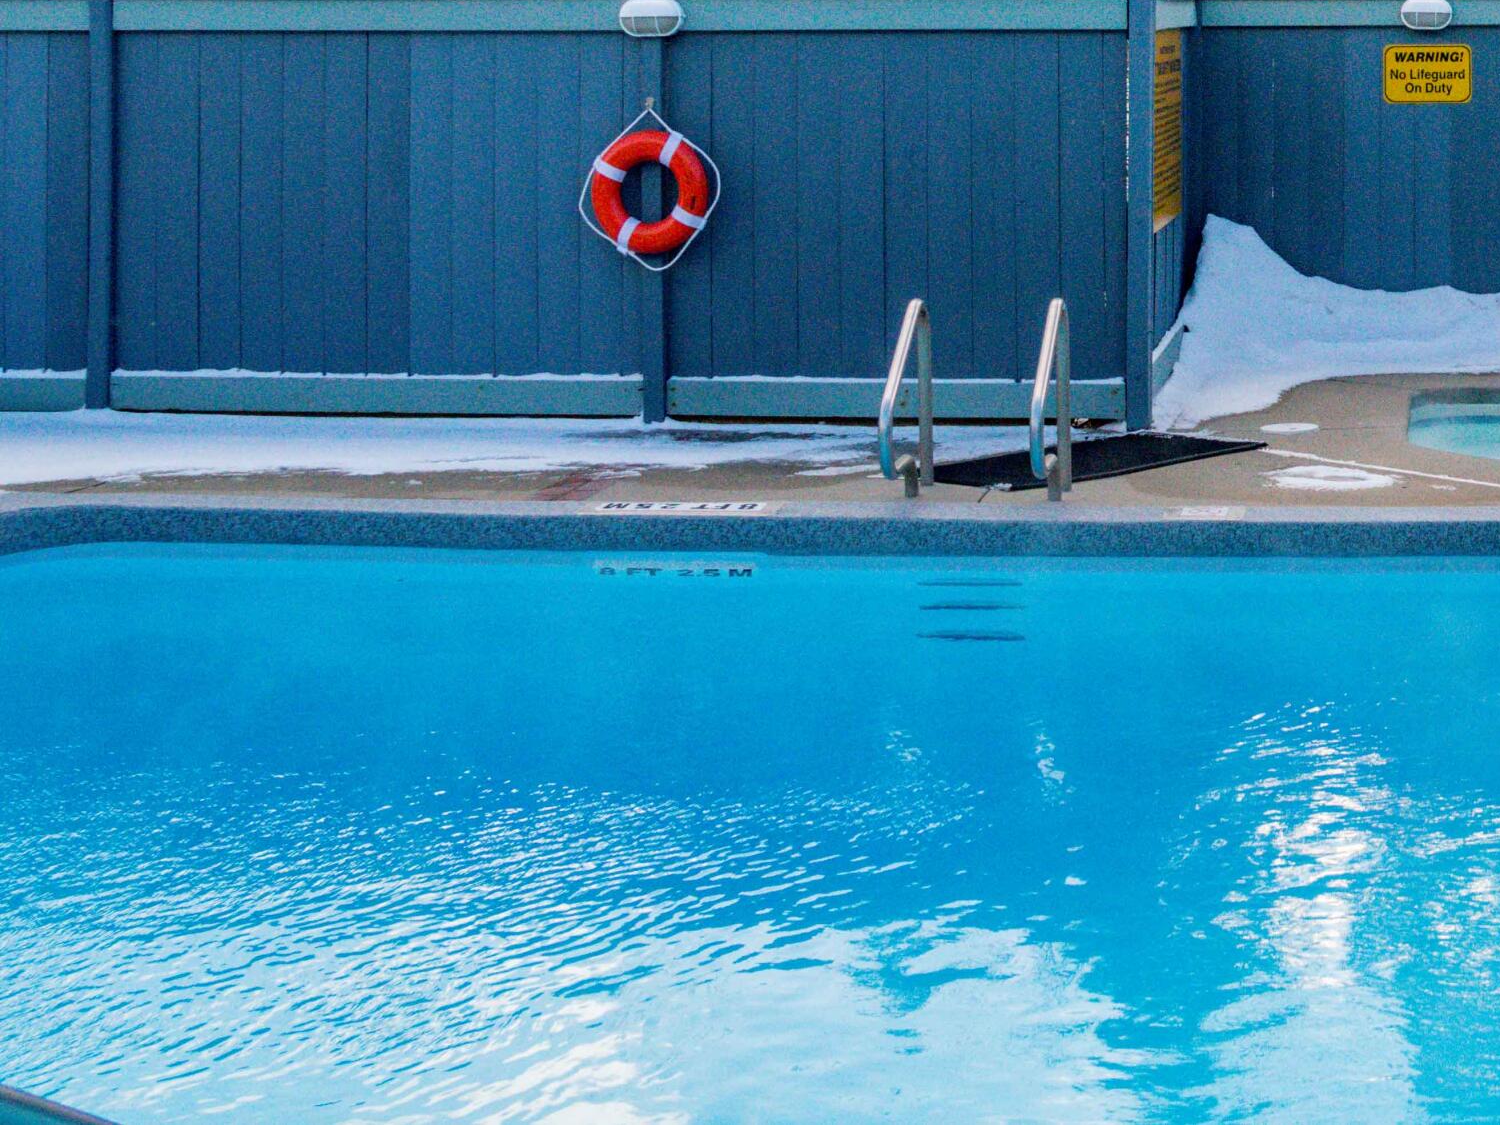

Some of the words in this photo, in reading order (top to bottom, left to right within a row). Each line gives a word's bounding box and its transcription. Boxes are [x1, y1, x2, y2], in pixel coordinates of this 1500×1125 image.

[1394, 52, 1464, 63] WARNING!
[1390, 69, 1407, 80] No
[1410, 69, 1465, 82] Lifeguard
[1405, 82, 1422, 93] On
[1425, 82, 1453, 96] Duty
